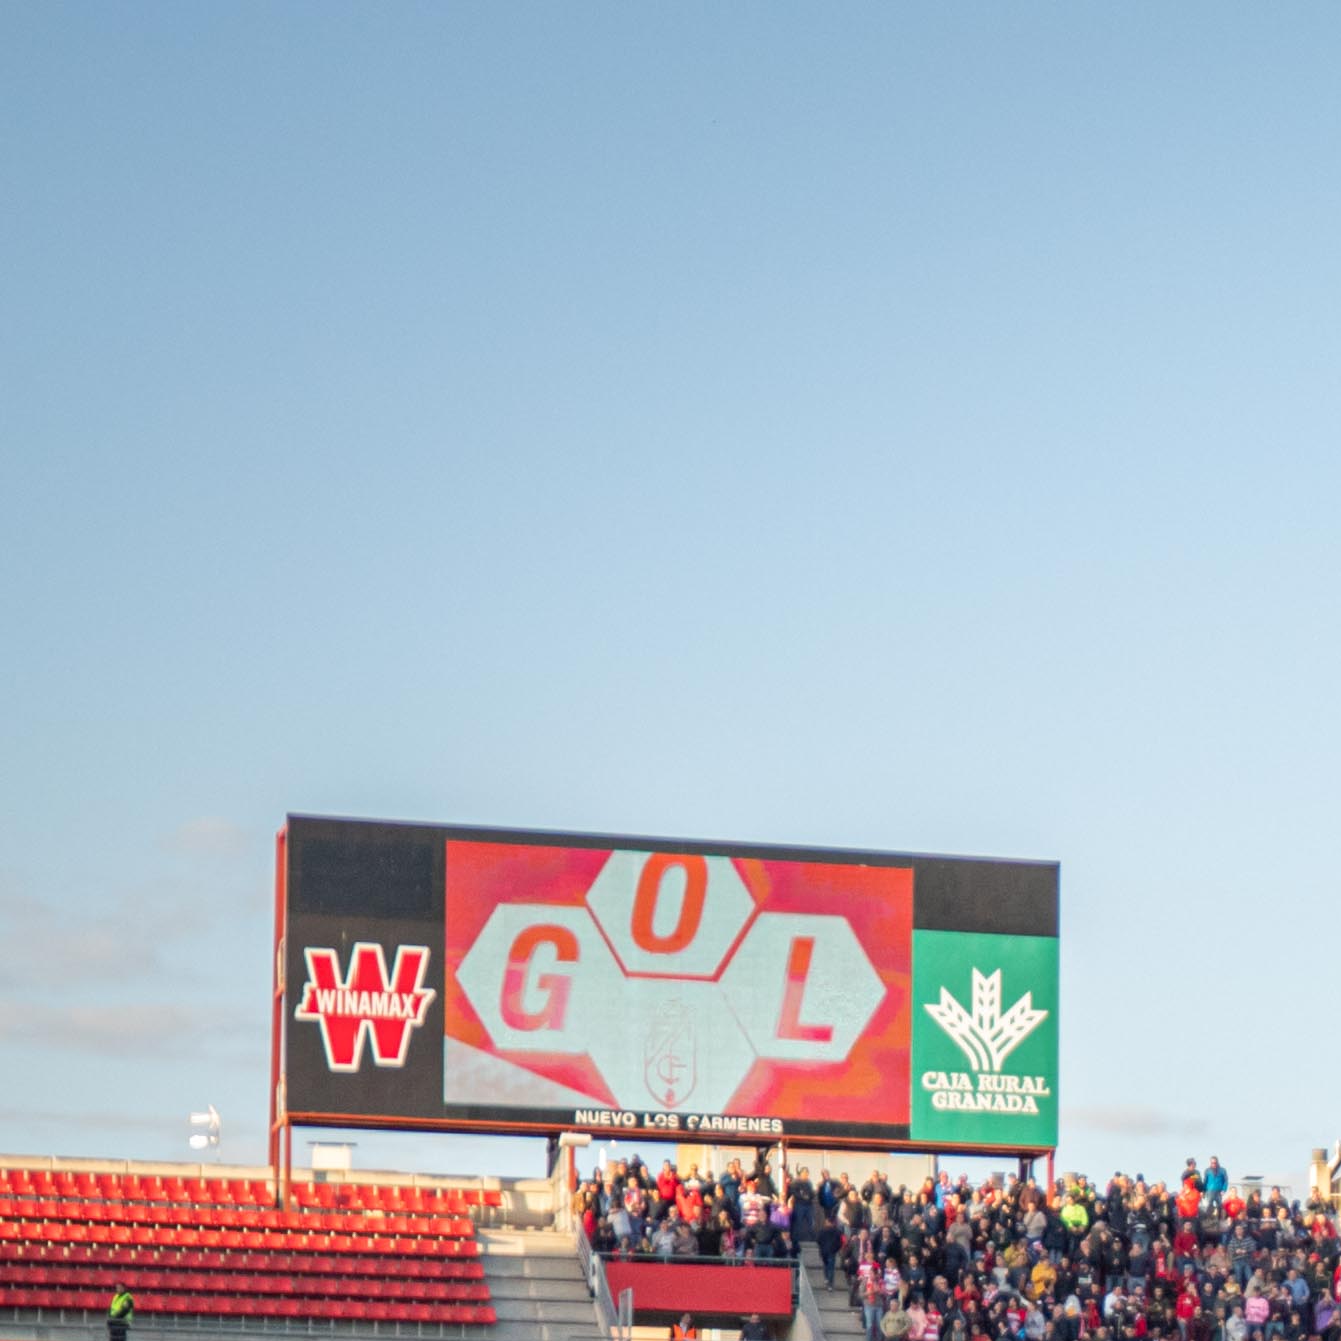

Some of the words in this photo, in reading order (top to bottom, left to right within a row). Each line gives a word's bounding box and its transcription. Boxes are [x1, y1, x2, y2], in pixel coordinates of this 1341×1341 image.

[315, 988, 416, 1019] WINAMAX
[921, 1071, 973, 1091] CAJA
[977, 1073, 1050, 1095] RURAL
[931, 1091, 1039, 1114] GRANADA
[575, 1109, 637, 1127] NUEVO
[644, 1113, 680, 1129] LOS
[687, 1114, 784, 1133] CARMENES
